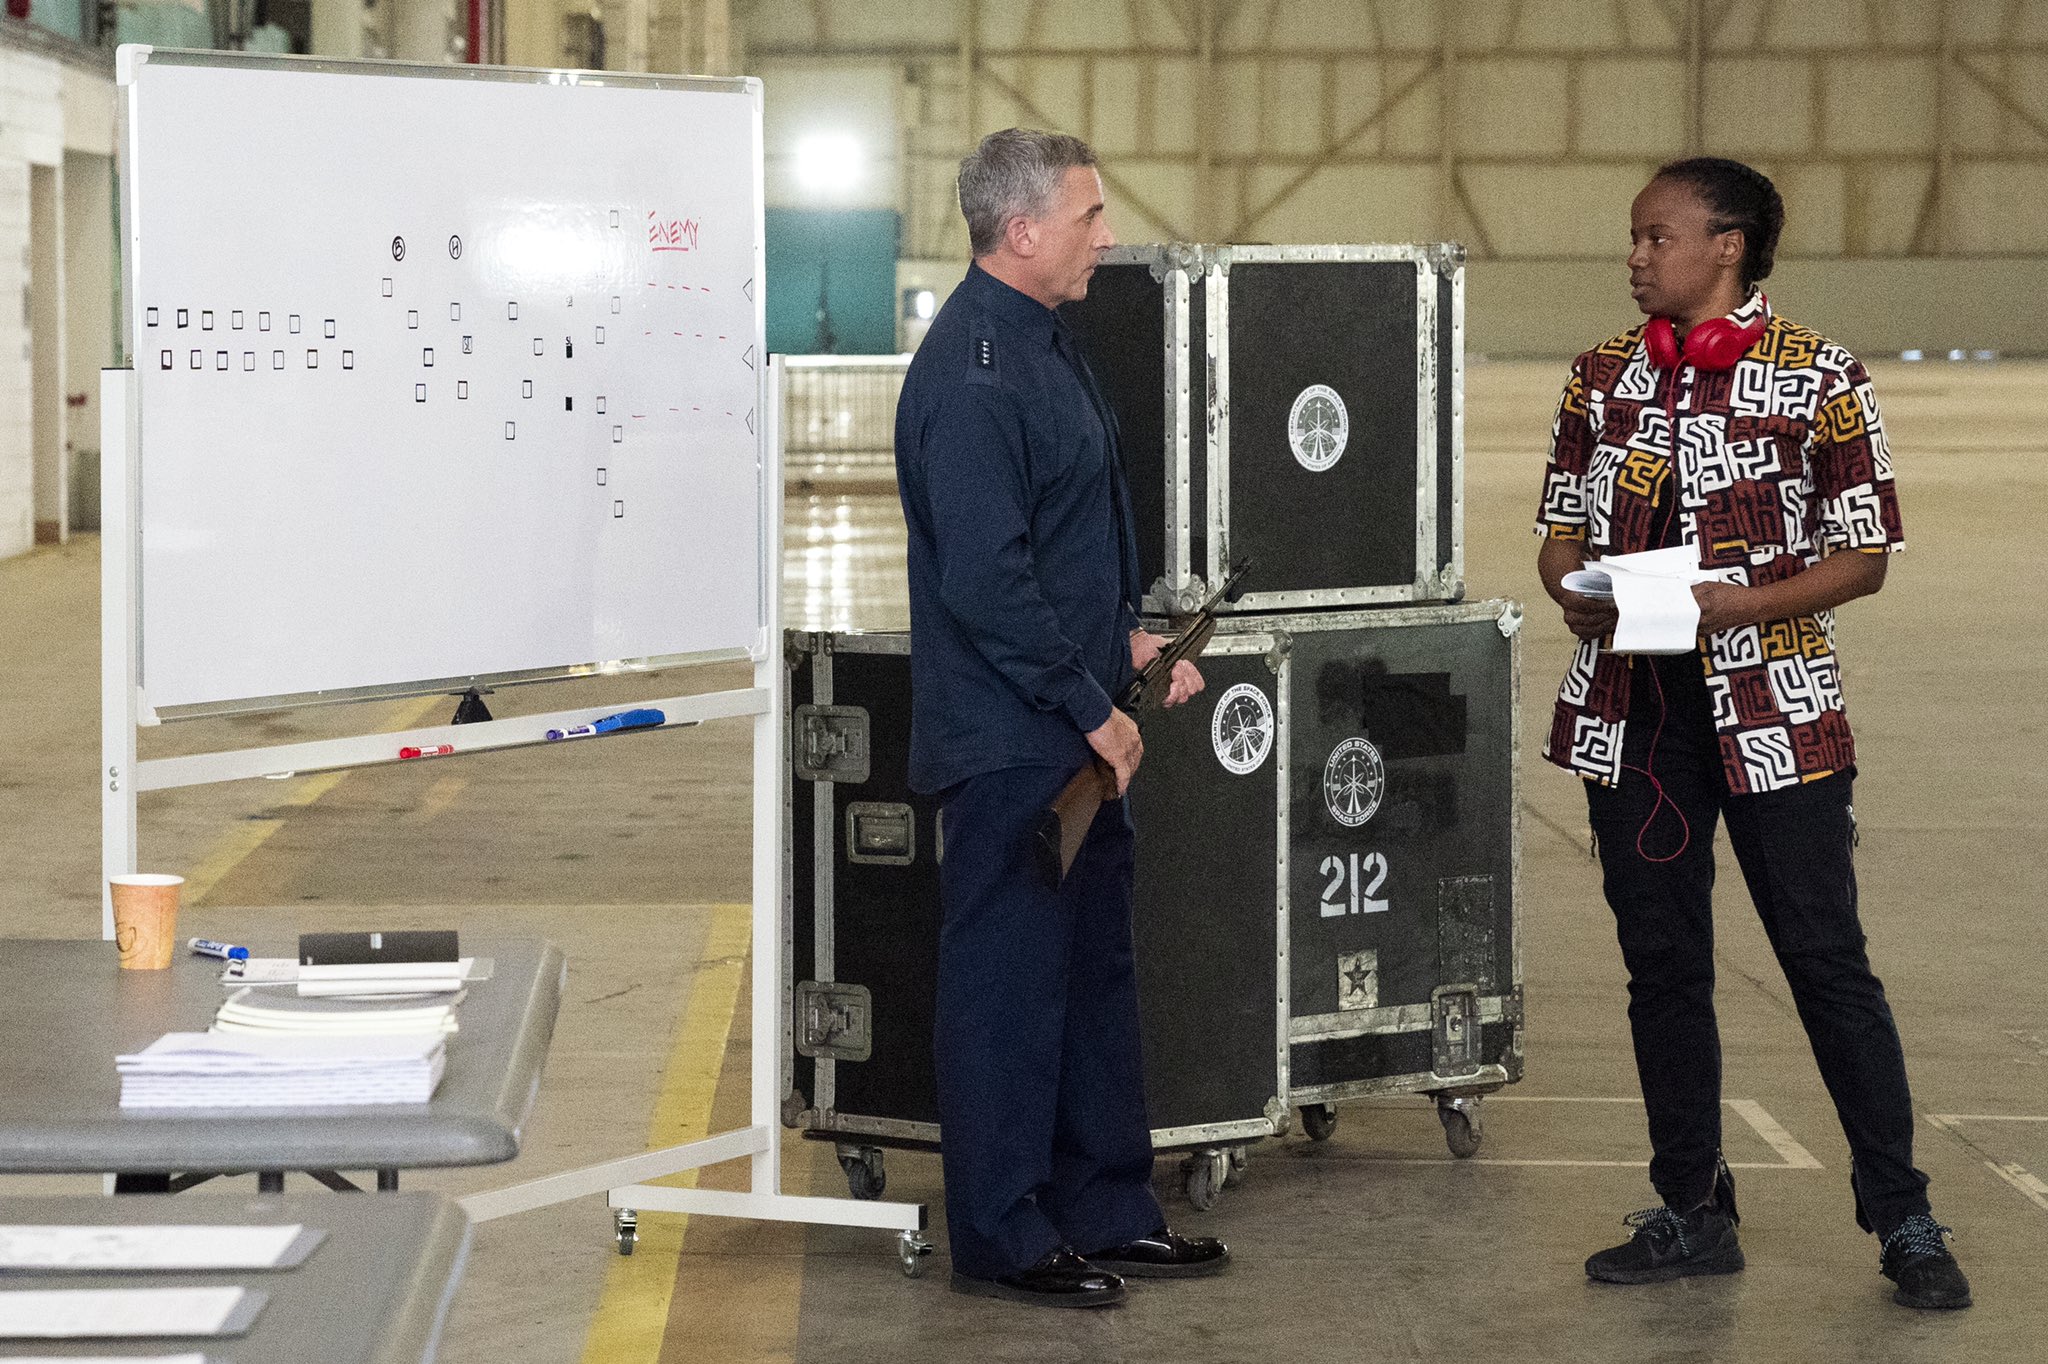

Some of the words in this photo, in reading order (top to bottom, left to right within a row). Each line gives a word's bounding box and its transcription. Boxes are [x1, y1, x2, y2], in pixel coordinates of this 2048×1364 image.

[648, 210, 698, 250] ENEMY
[1290, 391, 1308, 435] DEPARTMENT
[1317, 386, 1328, 394] THE
[1328, 390, 1343, 408] SPACE
[1213, 702, 1224, 752] DEPARTMENT
[1223, 692, 1231, 702] OF
[1231, 685, 1242, 694] THE
[1243, 685, 1260, 697] SPACE
[1260, 695, 1271, 719] FORCE
[1329, 741, 1353, 767] UNITED
[1354, 740, 1379, 763] STATES
[1331, 805, 1354, 824] SPACE
[1355, 800, 1377, 823] FORCE
[1319, 852, 1389, 918] 212
